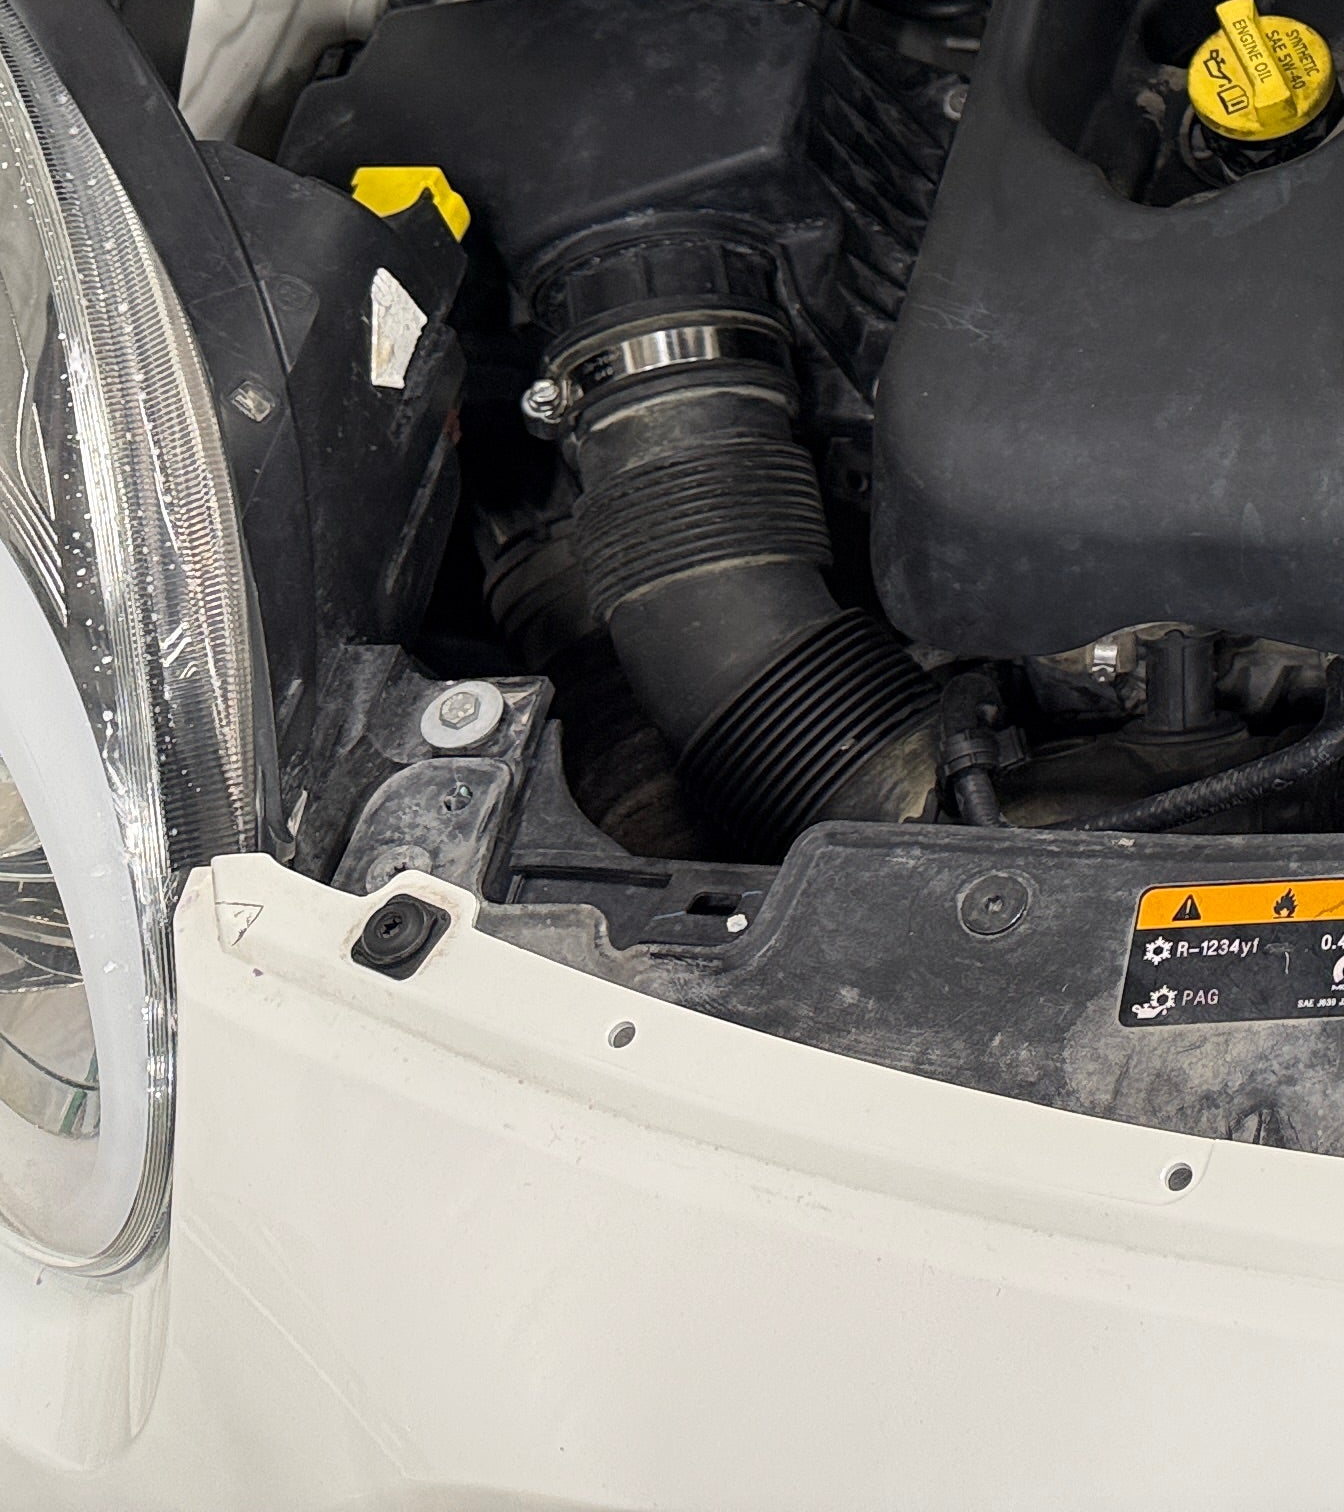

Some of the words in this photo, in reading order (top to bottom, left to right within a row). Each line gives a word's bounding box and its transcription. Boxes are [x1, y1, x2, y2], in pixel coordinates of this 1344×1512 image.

[1231, 18, 1264, 62] ENGINE
[1254, 62, 1273, 84] OIL
[1265, 29, 1285, 53] SAE
[1277, 52, 1307, 90] 5W-40
[1285, 28, 1321, 78] SYNTHETIC
[1176, 937, 1260, 957] R-1234yf
[1181, 988, 1220, 1007] PAG
[1297, 999, 1315, 1008] SAE
